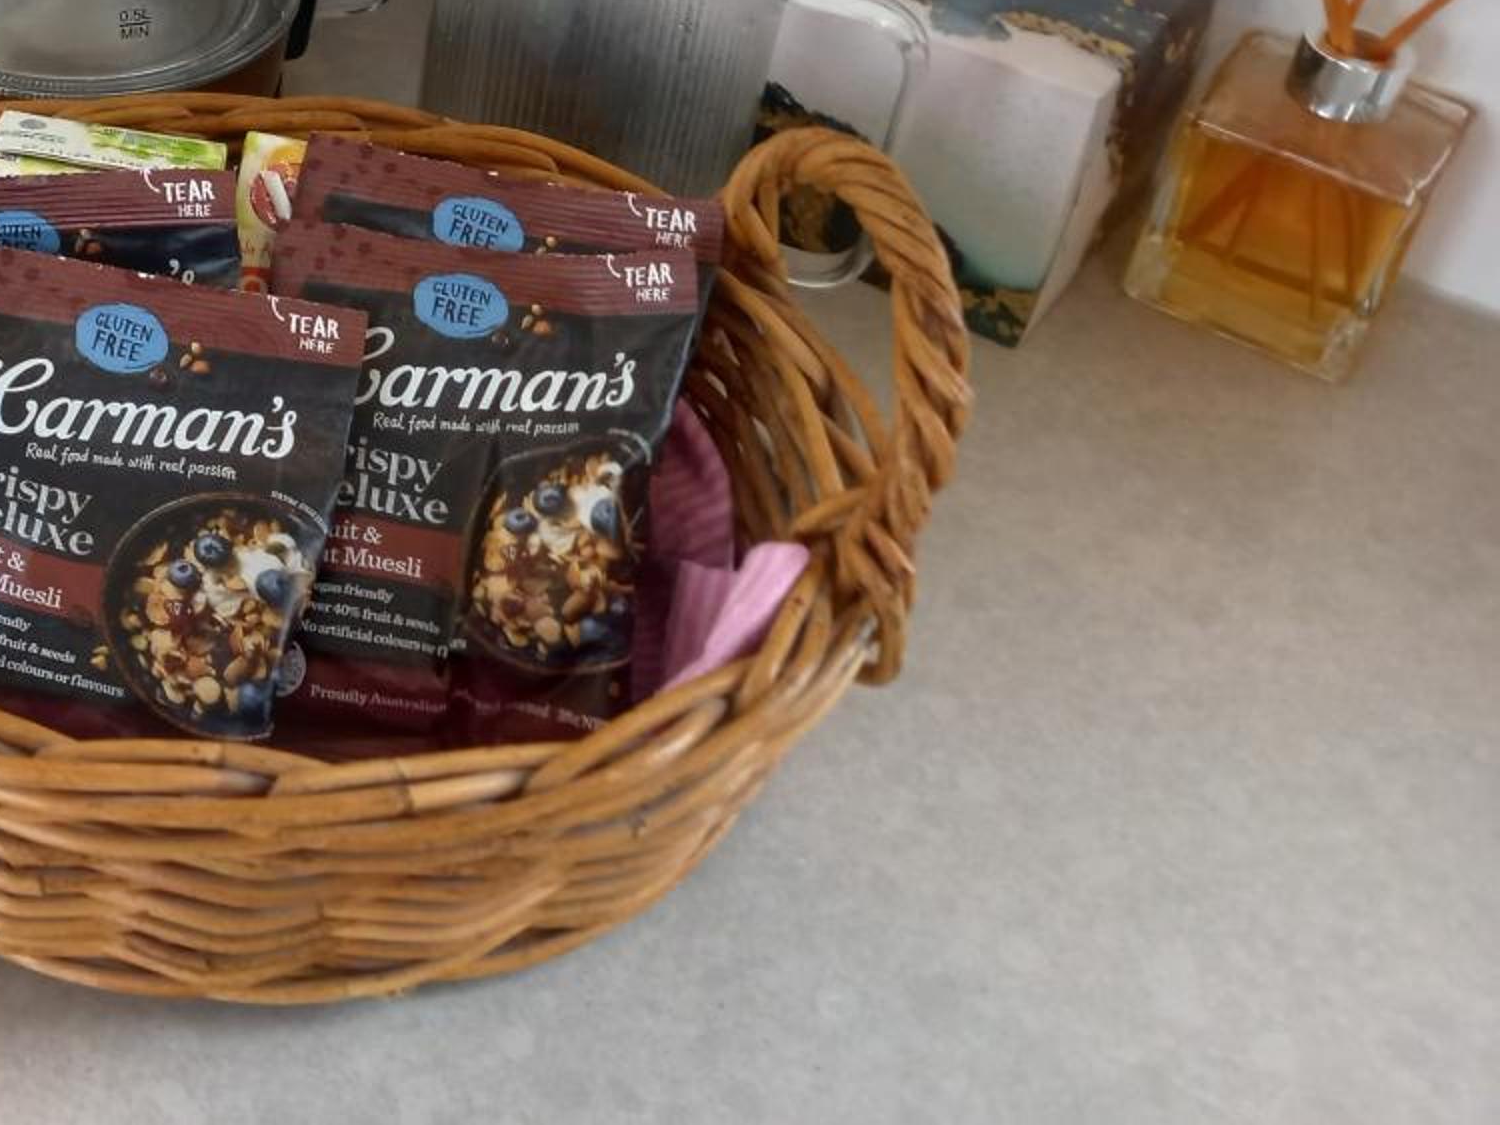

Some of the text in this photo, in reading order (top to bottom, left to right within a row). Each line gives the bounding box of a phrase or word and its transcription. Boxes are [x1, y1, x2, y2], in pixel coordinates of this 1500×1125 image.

[121, 25, 149, 39] MIN
[163, 179, 216, 203] TEAR
[177, 203, 211, 218] HERE
[452, 203, 508, 233] GLUTEN
[645, 208, 697, 232] TEAR
[449, 222, 498, 250] FREE
[655, 232, 692, 248] HERE
[624, 262, 674, 287] TEAR
[432, 281, 492, 307] GLUTEN
[635, 287, 670, 302] HERE
[431, 298, 484, 327] FREE
[95, 312, 154, 342] GLUTEN
[288, 312, 340, 340] TEAR
[92, 330, 145, 363] FREE
[300, 338, 335, 355] HERE
[373, 412, 404, 432] Real
[407, 413, 437, 435] food
[439, 416, 472, 432] made
[475, 418, 501, 434] with
[505, 418, 532, 434] real
[25, 442, 238, 481] Real food made with real passion
[346, 436, 443, 492] ispy
[335, 472, 450, 525] eluxe
[363, 526, 383, 545] &
[7, 551, 27, 572] &
[343, 546, 422, 578] Muesli
[343, 583, 394, 604] friendly
[361, 608, 392, 626] fruit
[318, 624, 373, 644] artificial
[373, 634, 422, 652] colours
[27, 642, 40, 655] &
[40, 648, 77, 665] seeds
[6, 658, 54, 681] colours
[54, 671, 70, 685] or
[69, 673, 125, 699] flavours
[310, 684, 368, 707] Proudly
